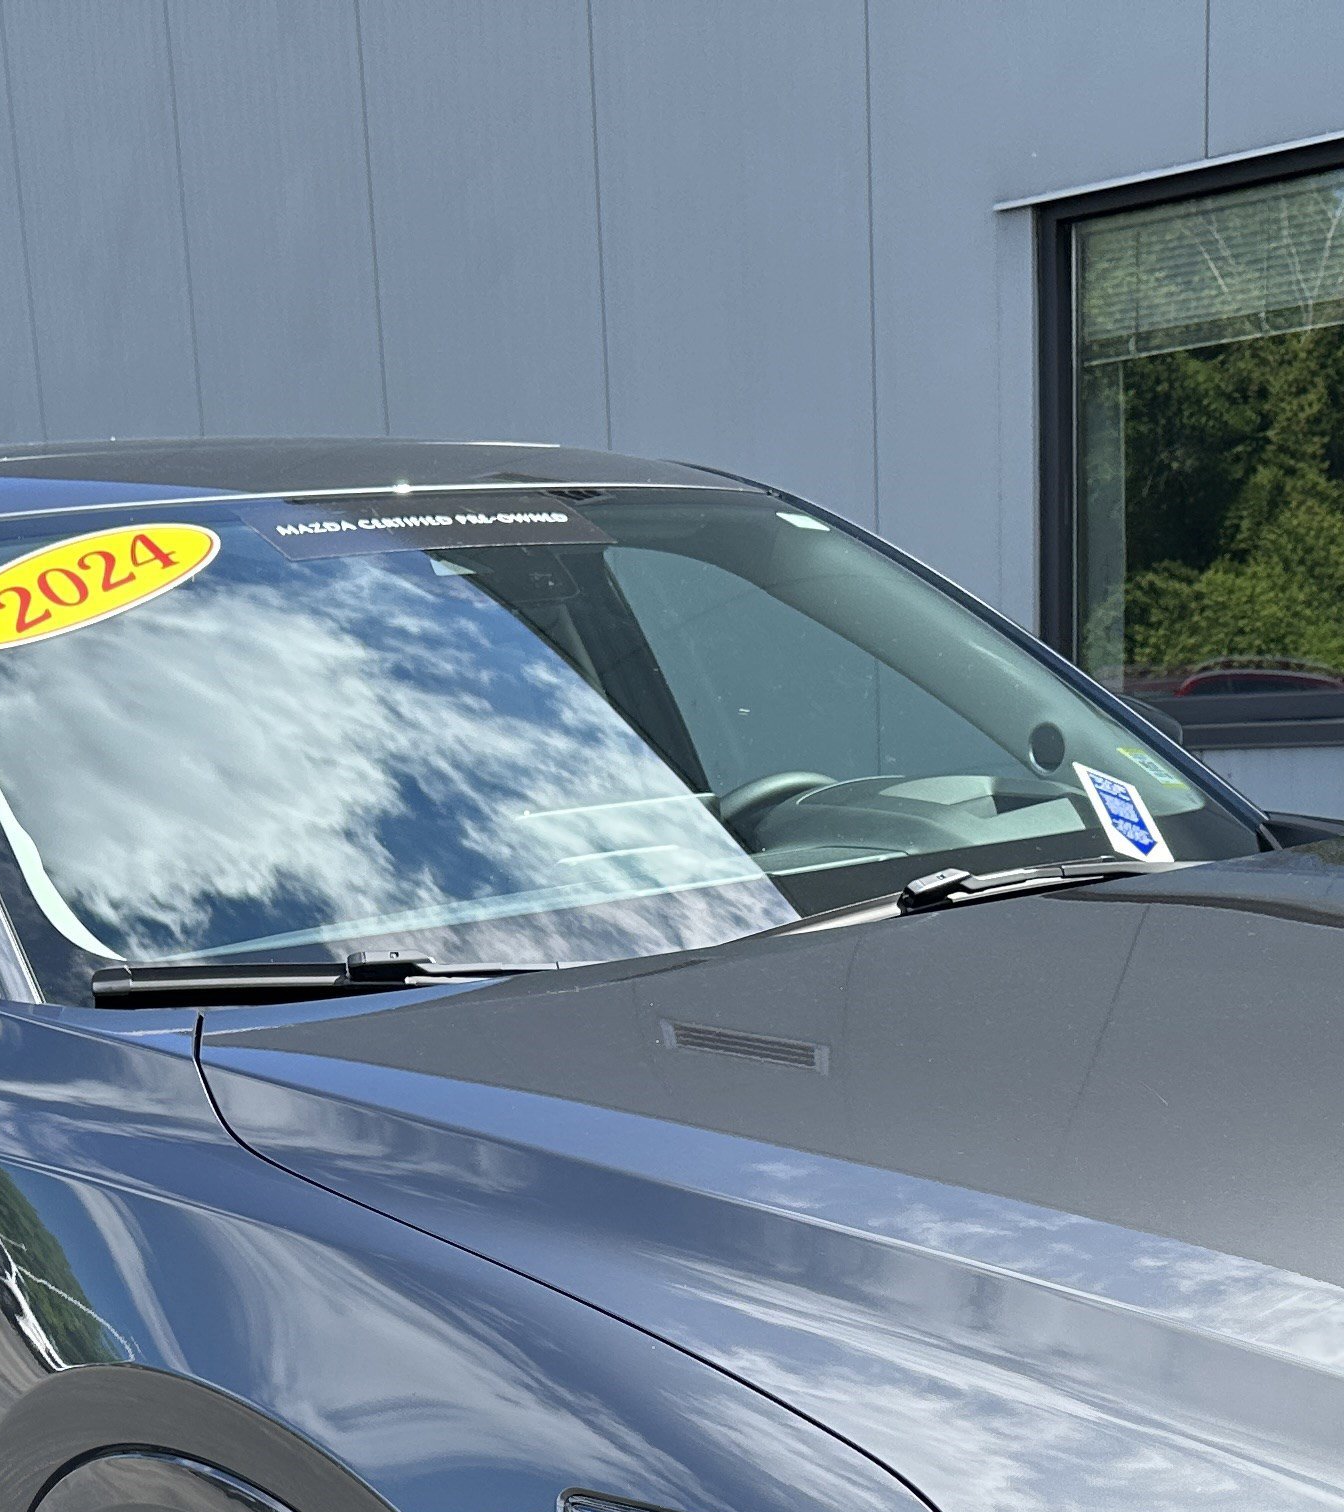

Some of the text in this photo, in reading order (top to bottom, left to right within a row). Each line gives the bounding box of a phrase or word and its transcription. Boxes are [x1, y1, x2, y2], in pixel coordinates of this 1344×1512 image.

[276, 511, 569, 537] MAZDA CERTIFIED PRE-OWNED
